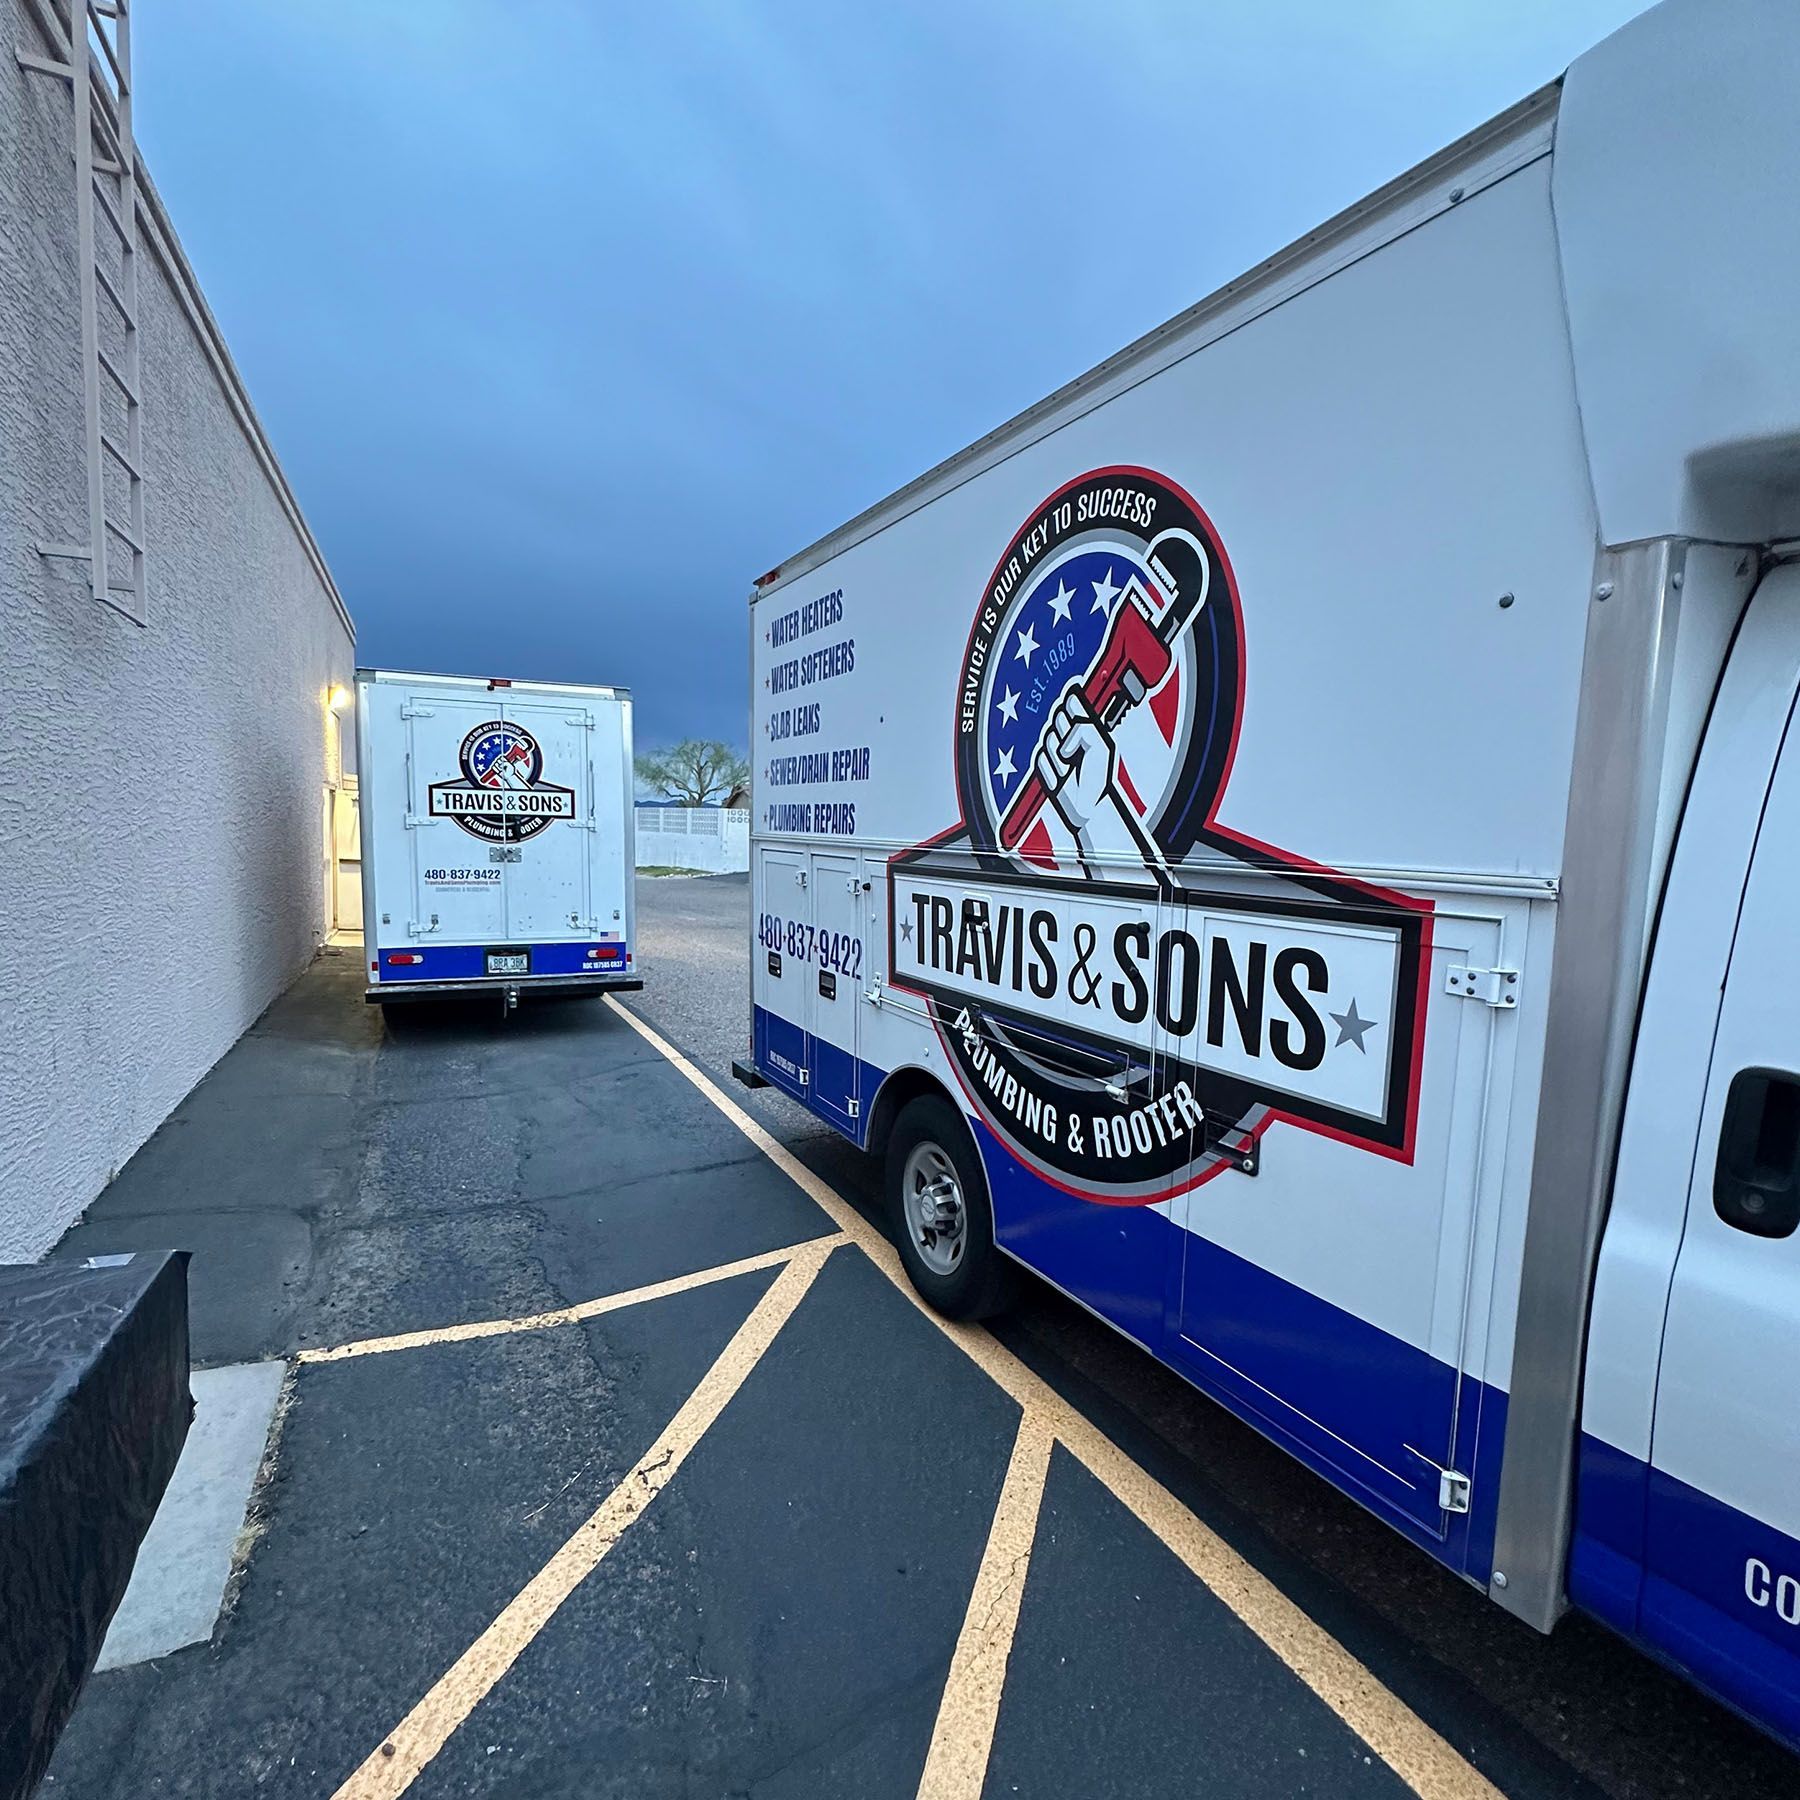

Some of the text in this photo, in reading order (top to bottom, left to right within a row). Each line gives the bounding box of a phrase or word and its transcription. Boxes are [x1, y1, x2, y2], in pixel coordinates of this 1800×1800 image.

[771, 588, 843, 649] WATER HEATERS
[962, 487, 1157, 733] SERVICE IS OUR KEY TO SUCCESS
[771, 638, 855, 695] WATER SOFTENERS
[1043, 632, 1076, 676] 1989
[770, 702, 821, 742] SLAB LEAKS
[770, 747, 870, 786] SEWER/DRAIN REPAIR
[442, 792, 563, 813] TRAVIS & SONS
[768, 803, 856, 835] PLUMBING REPAIRS
[463, 815, 543, 837] PLUMBING & OOTER
[911, 893, 1329, 1071] TRAVIS & SONS
[952, 1006, 1205, 1158] PLUMBING & ROOTER
